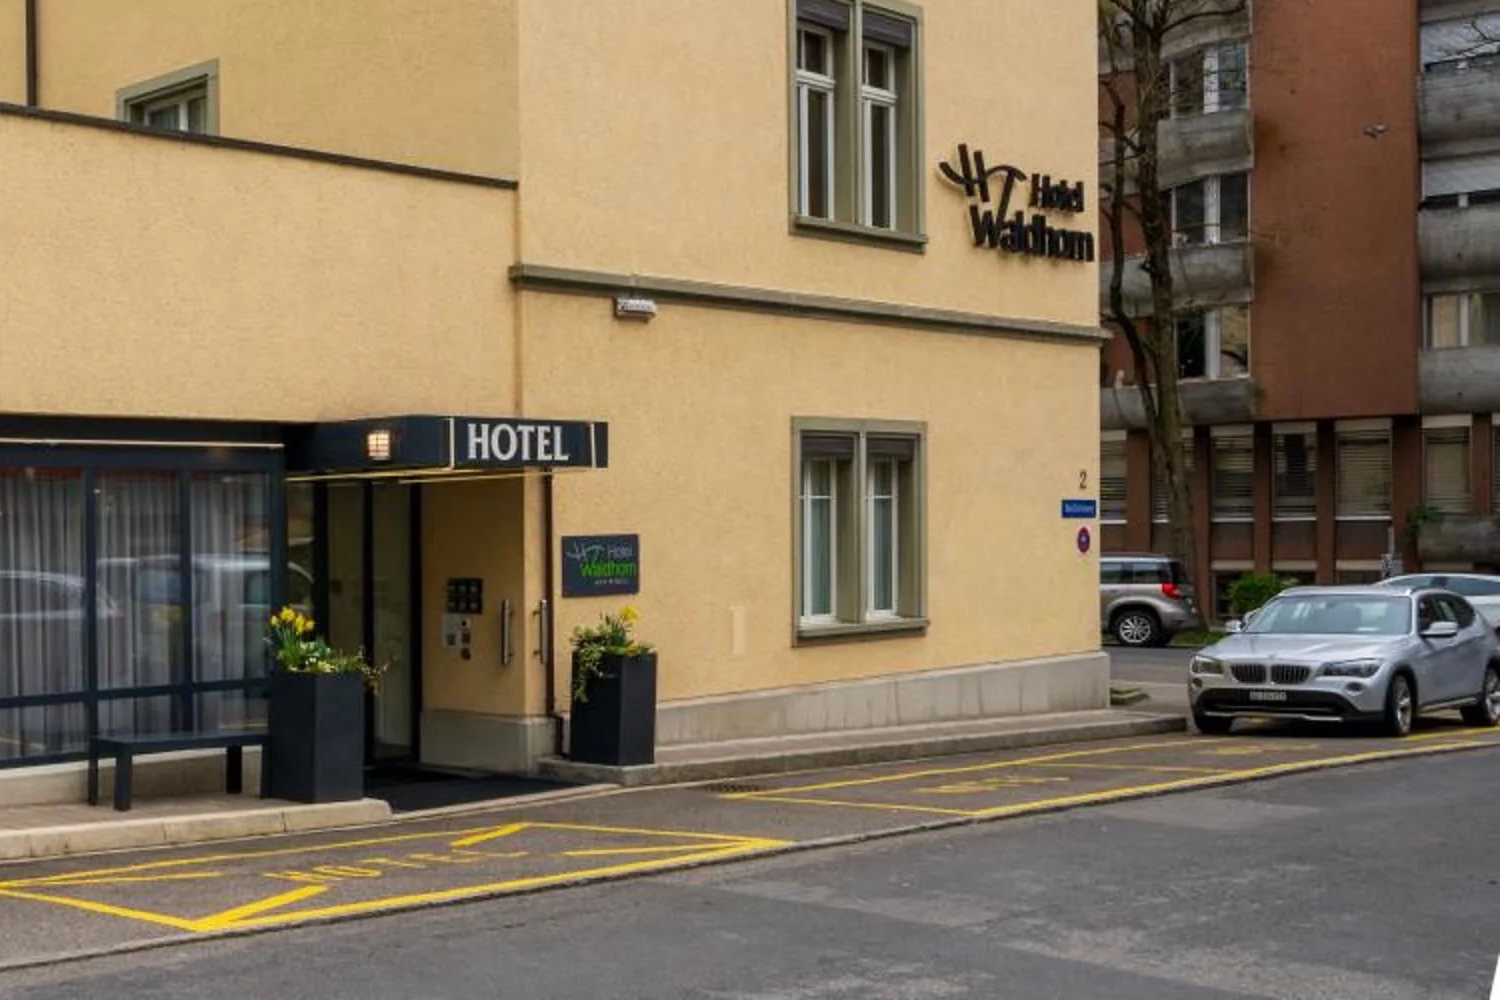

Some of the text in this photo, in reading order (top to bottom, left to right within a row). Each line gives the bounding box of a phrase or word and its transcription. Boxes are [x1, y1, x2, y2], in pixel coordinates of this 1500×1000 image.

[1030, 174, 1085, 213] Hotel
[467, 423, 569, 461] HOTEL
[1079, 470, 1088, 490] 2
